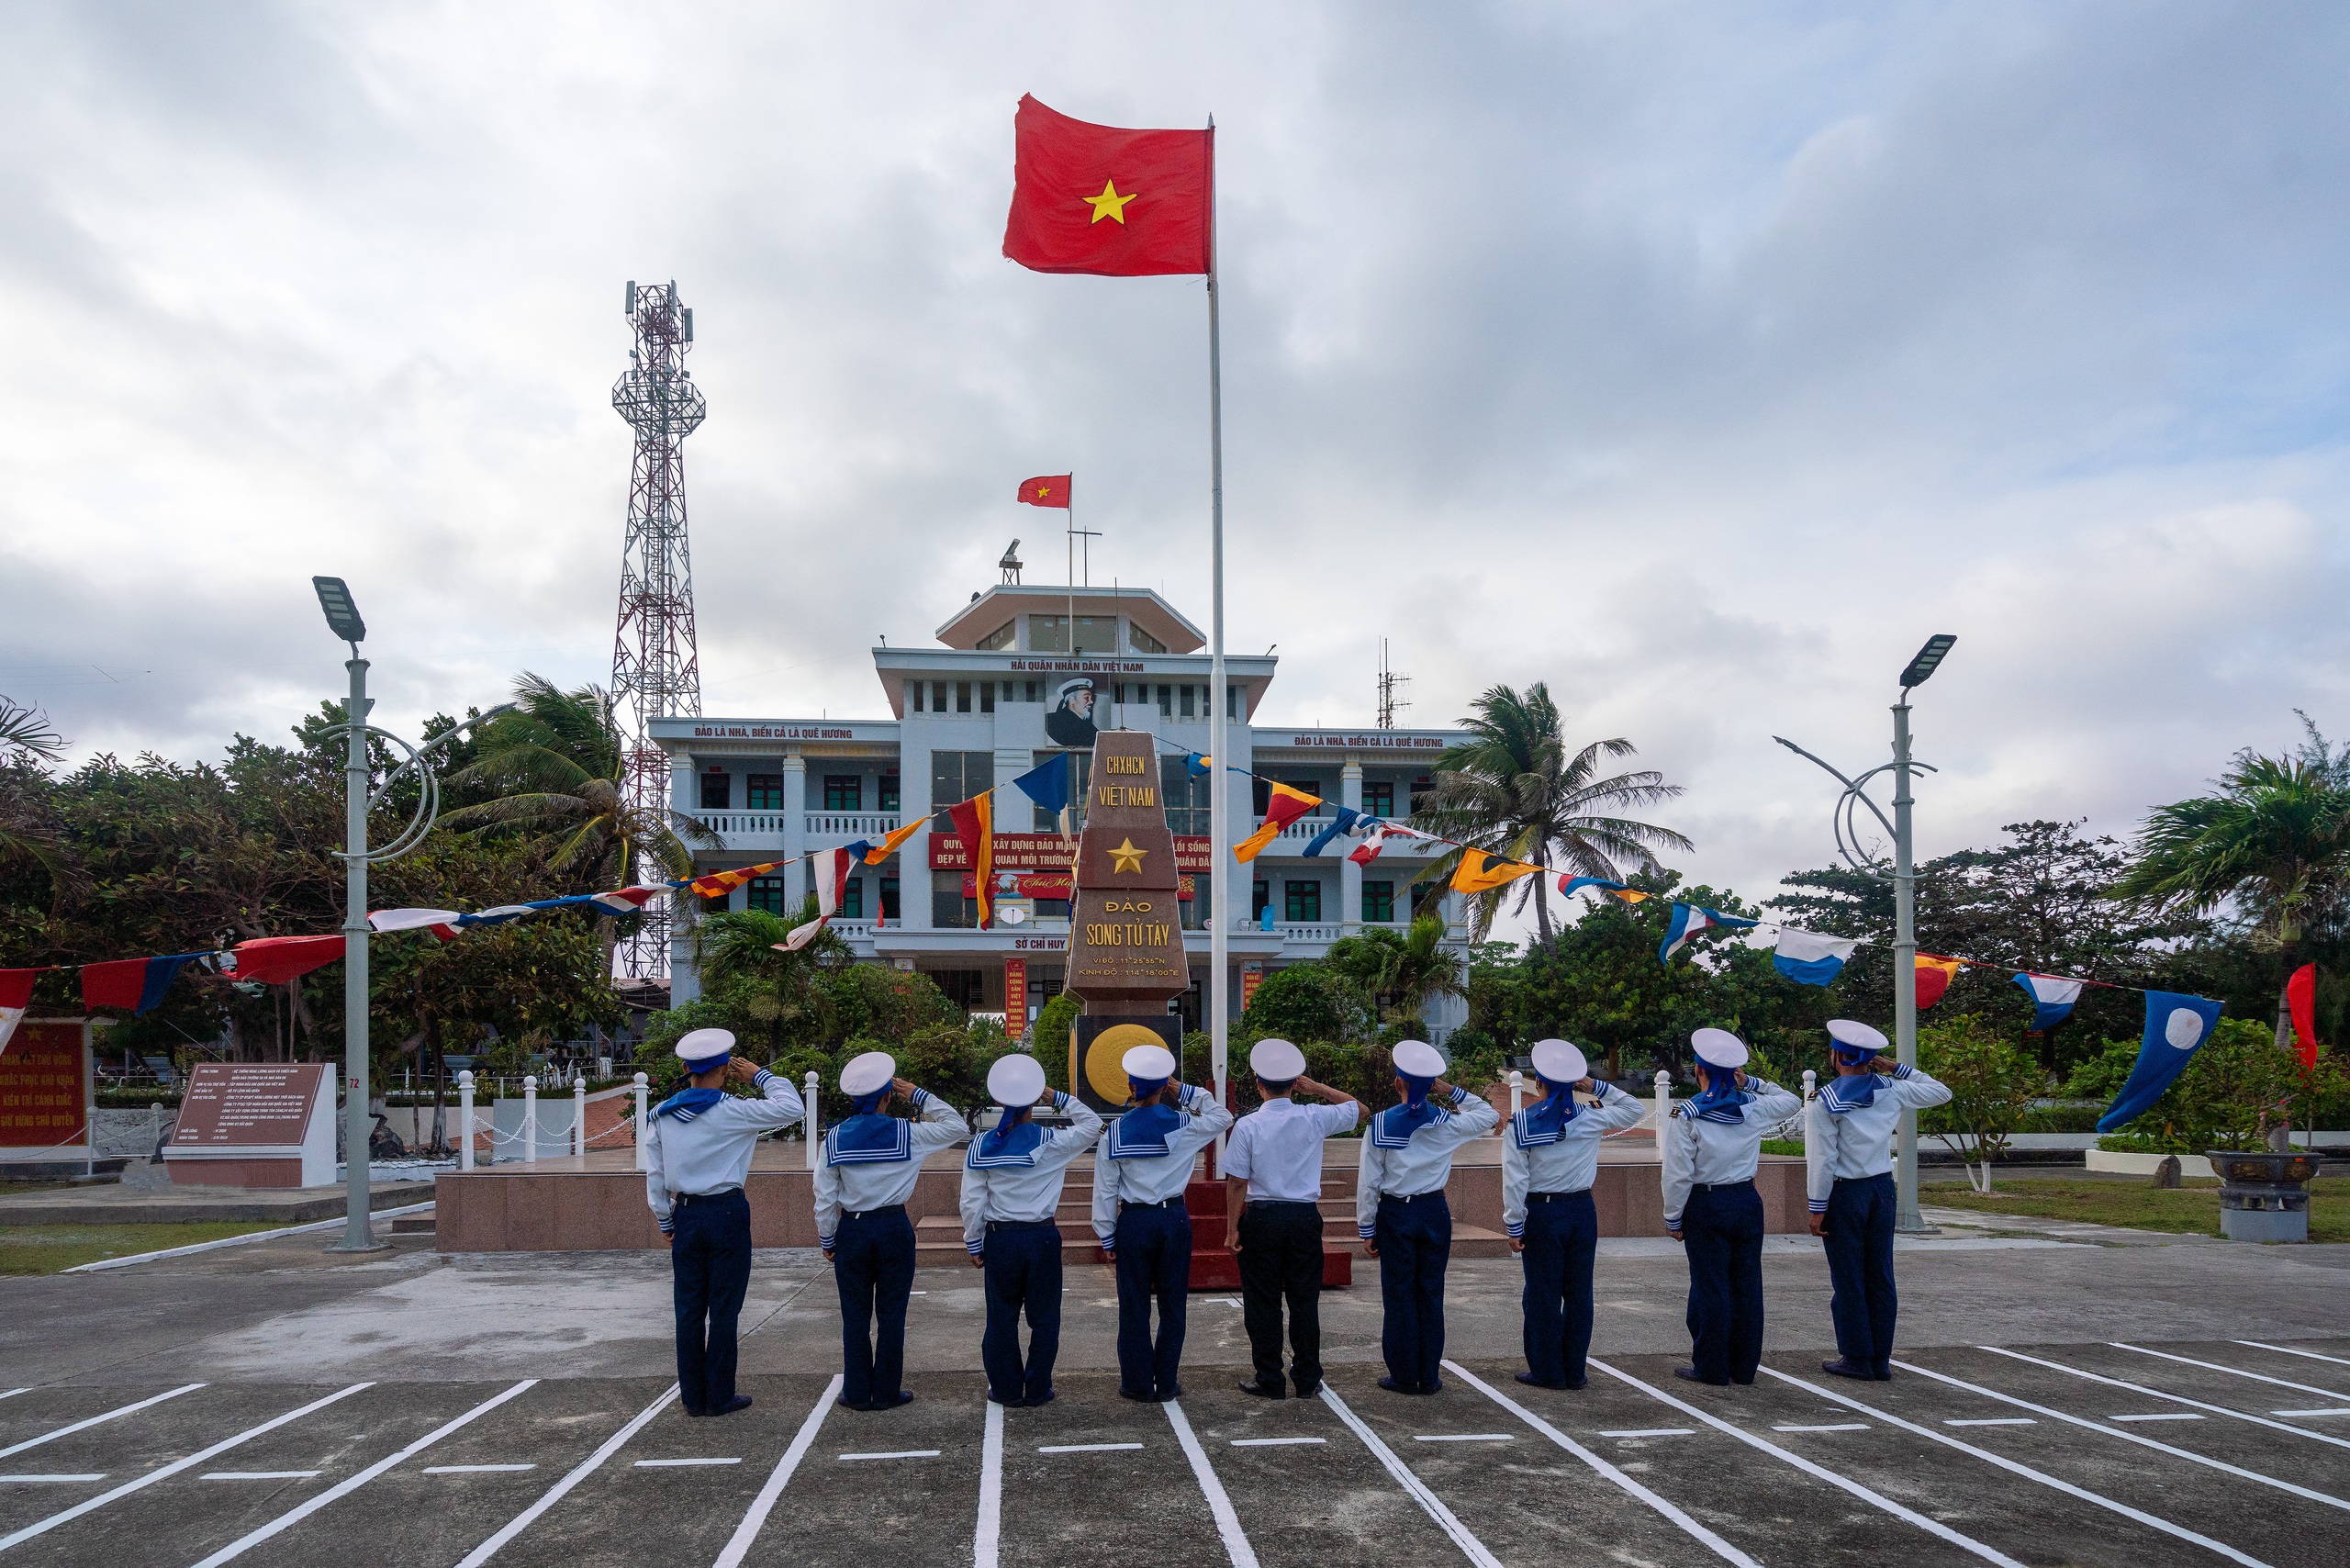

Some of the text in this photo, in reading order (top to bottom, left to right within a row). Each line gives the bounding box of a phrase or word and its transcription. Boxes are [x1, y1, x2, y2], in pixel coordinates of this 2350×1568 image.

[1011, 659, 1143, 672] HẢI QUÂN NHÂN DÂN VIỆT NAM
[695, 724, 852, 739] ĐẢO LÀ NHÀ, BIỂN CẢ LÀ QUÊ HƯƠNG
[1295, 734, 1443, 748] ĐẢO LÀ NHÀ, BIỂN CẢ LÀ QUÊ HƯƠNG
[1106, 756, 1145, 774] CHXHCN
[1099, 783, 1154, 809] VIỆT NAM
[943, 839, 963, 849] QUY
[993, 838, 1009, 850] XÂY
[1011, 840, 1034, 851] DỰNG
[1037, 838, 1053, 850] ĐẢO
[1188, 840, 1210, 852] SỐNG
[937, 854, 954, 865] ĐẸP
[995, 855, 1018, 865] QUAN
[1021, 853, 1037, 864] MÔI
[1040, 853, 1072, 865] TRƯỜNG
[1105, 896, 1152, 912] ĐẢO
[1086, 918, 1170, 946] SONG TỬ TÂY
[1015, 936, 1065, 949] SỞ CHỈ HUY
[1103, 967, 1118, 977] ĐỘ
[350, 1078, 359, 1088] 72
